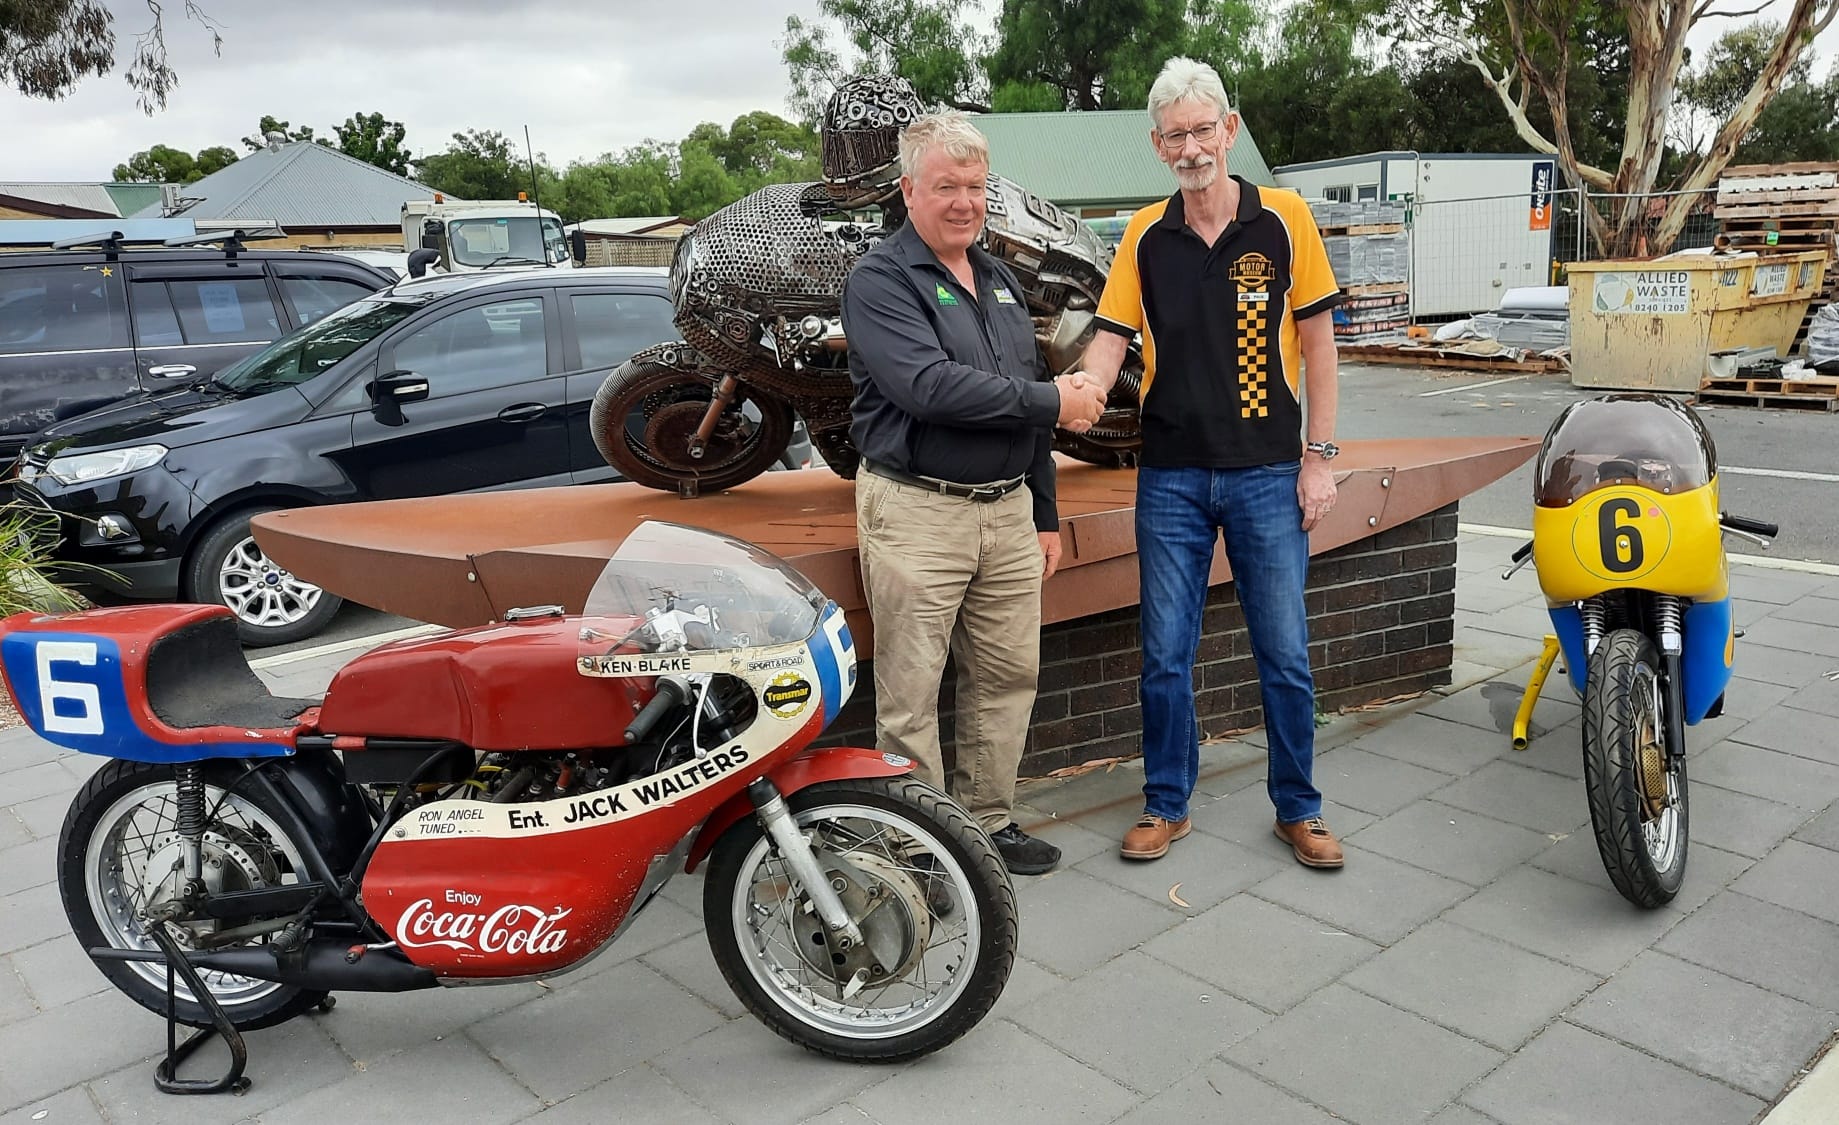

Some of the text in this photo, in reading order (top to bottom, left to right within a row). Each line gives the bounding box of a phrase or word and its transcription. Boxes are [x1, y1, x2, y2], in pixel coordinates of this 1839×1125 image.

[1239, 262, 1266, 271] MOTOR
[1637, 272, 1688, 284] ALLIED
[1637, 285, 1686, 297] WASTE
[1599, 497, 1644, 573] 6
[36, 640, 105, 735] 6
[766, 687, 809, 702] Transmar
[508, 744, 749, 830] Ent. JACK WALTERS
[418, 808, 485, 822] RON ANGEL
[445, 889, 482, 906] Enjoy
